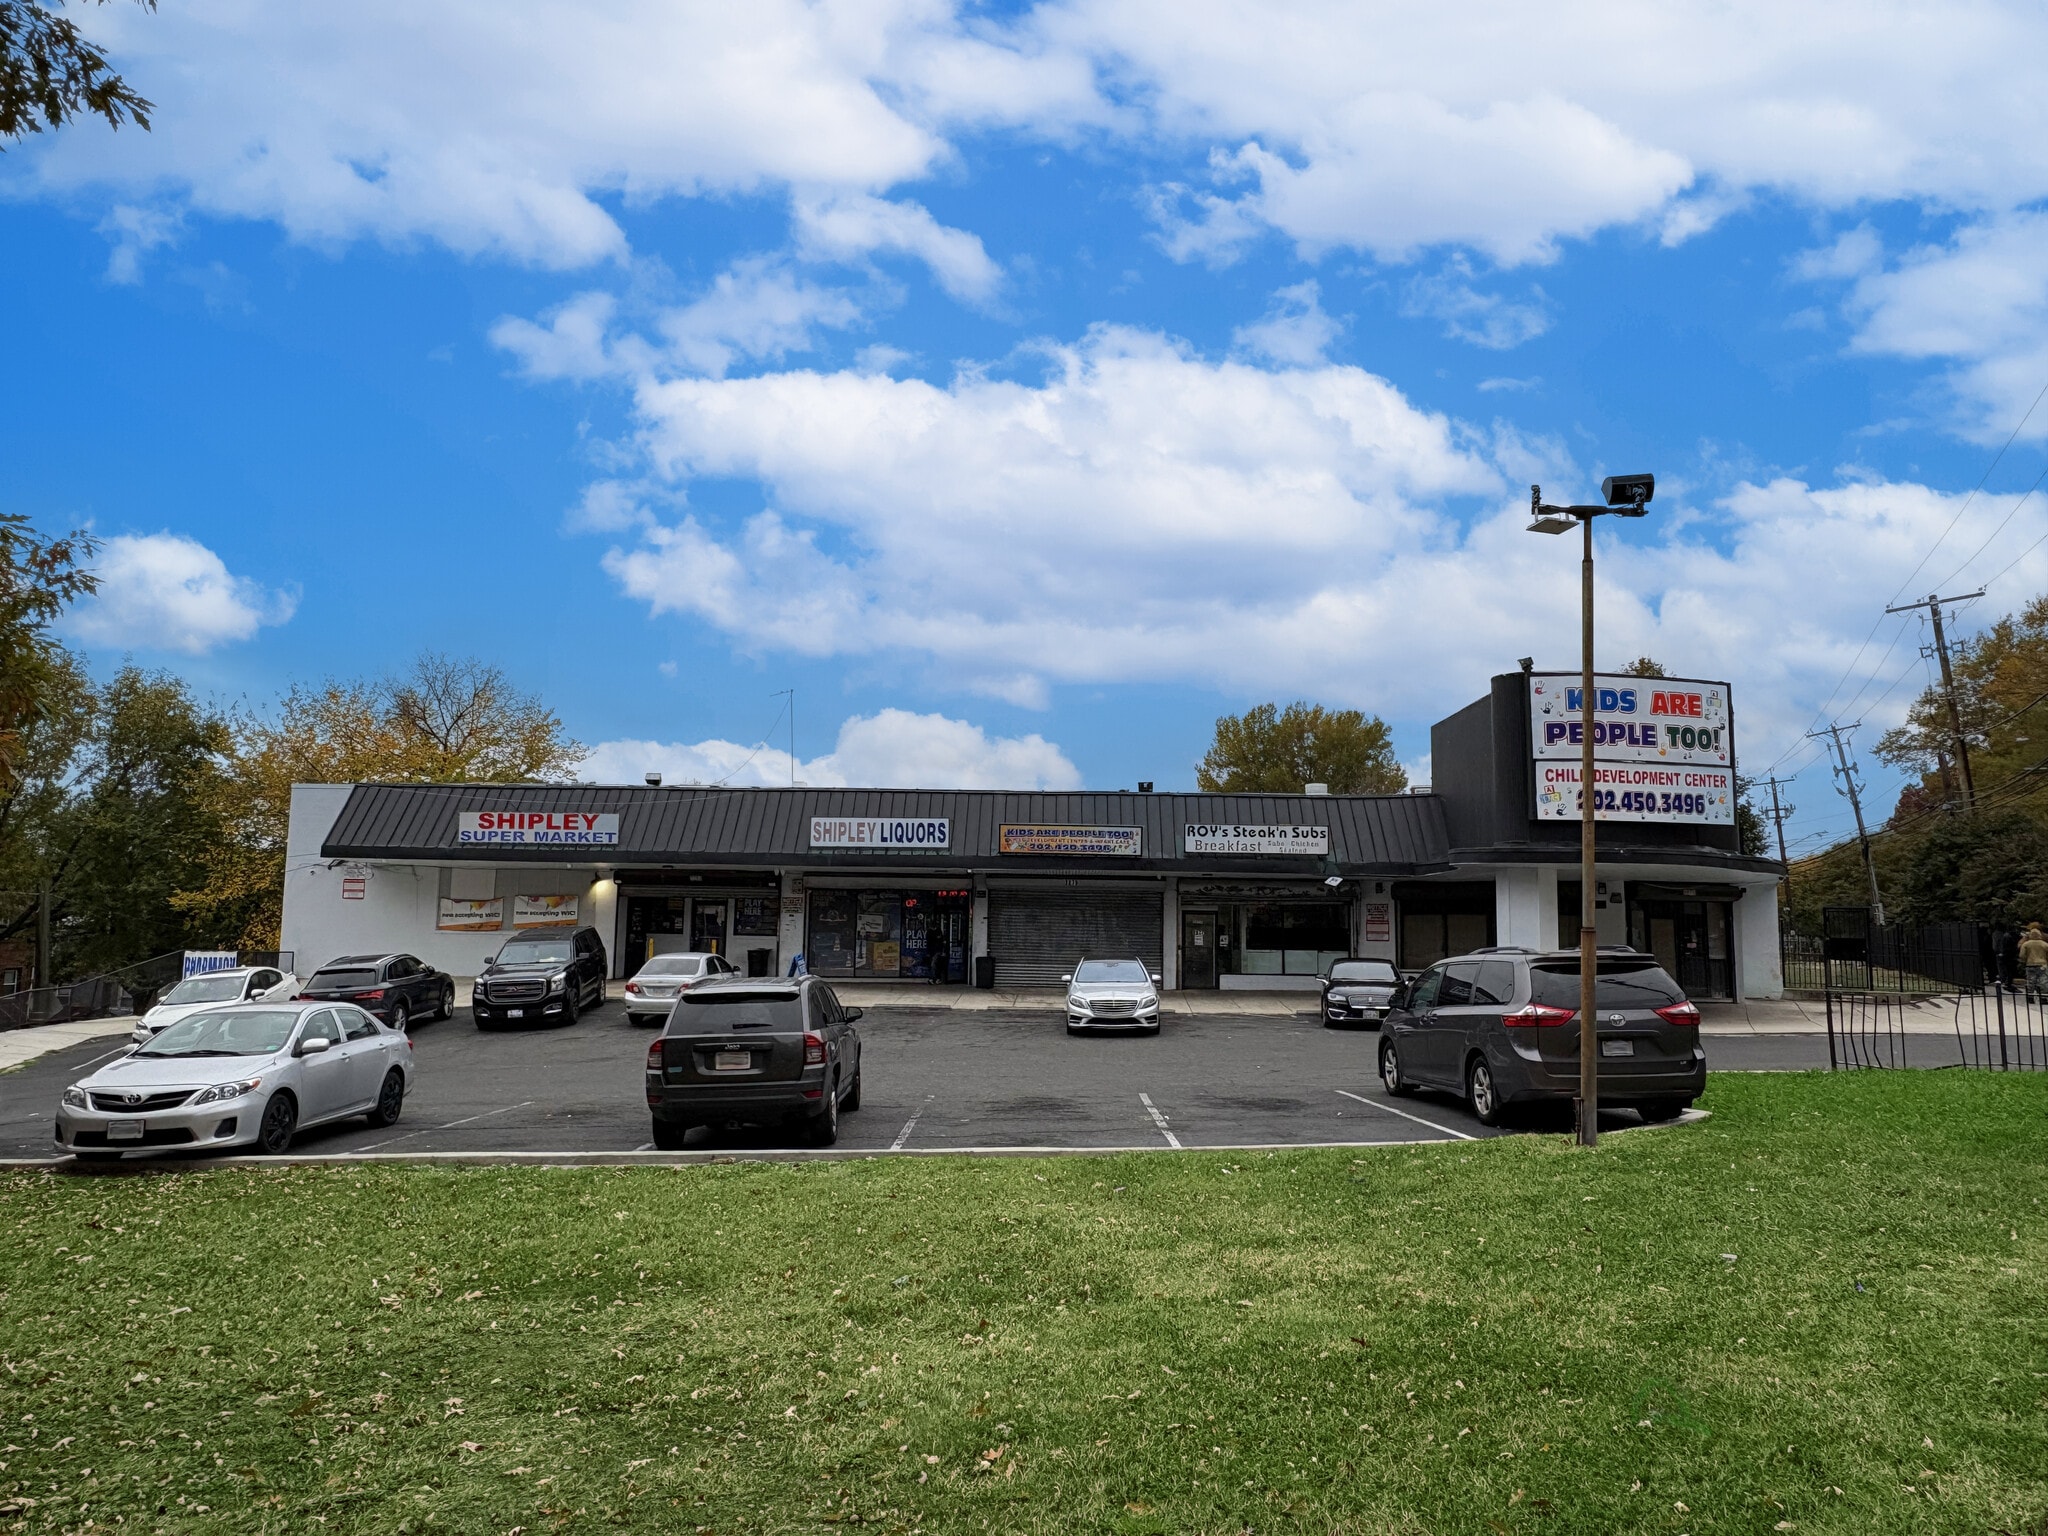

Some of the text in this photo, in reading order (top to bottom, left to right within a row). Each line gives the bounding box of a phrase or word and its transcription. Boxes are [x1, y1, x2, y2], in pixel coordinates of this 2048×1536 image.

[1650, 691, 1703, 718] ARE
[1544, 721, 1721, 752] PEOPLE TOO!
[1594, 770, 1680, 786] DEVELOPMENT
[1684, 774, 1727, 788] CENTER
[478, 812, 599, 831] SHIPLEY
[460, 830, 617, 843] SUPER MARKET
[813, 821, 946, 844] SHIPLEY LIQUORS
[1006, 828, 1035, 837] KIDS
[1061, 829, 1106, 838] PEOPLE
[1187, 825, 1327, 839] ROY's Steak'n Subs
[1195, 839, 1262, 852] Breakfast
[744, 898, 763, 906] PLAY
[744, 907, 762, 915] HERE
[906, 930, 928, 939] PLAY
[906, 940, 928, 949] HERE
